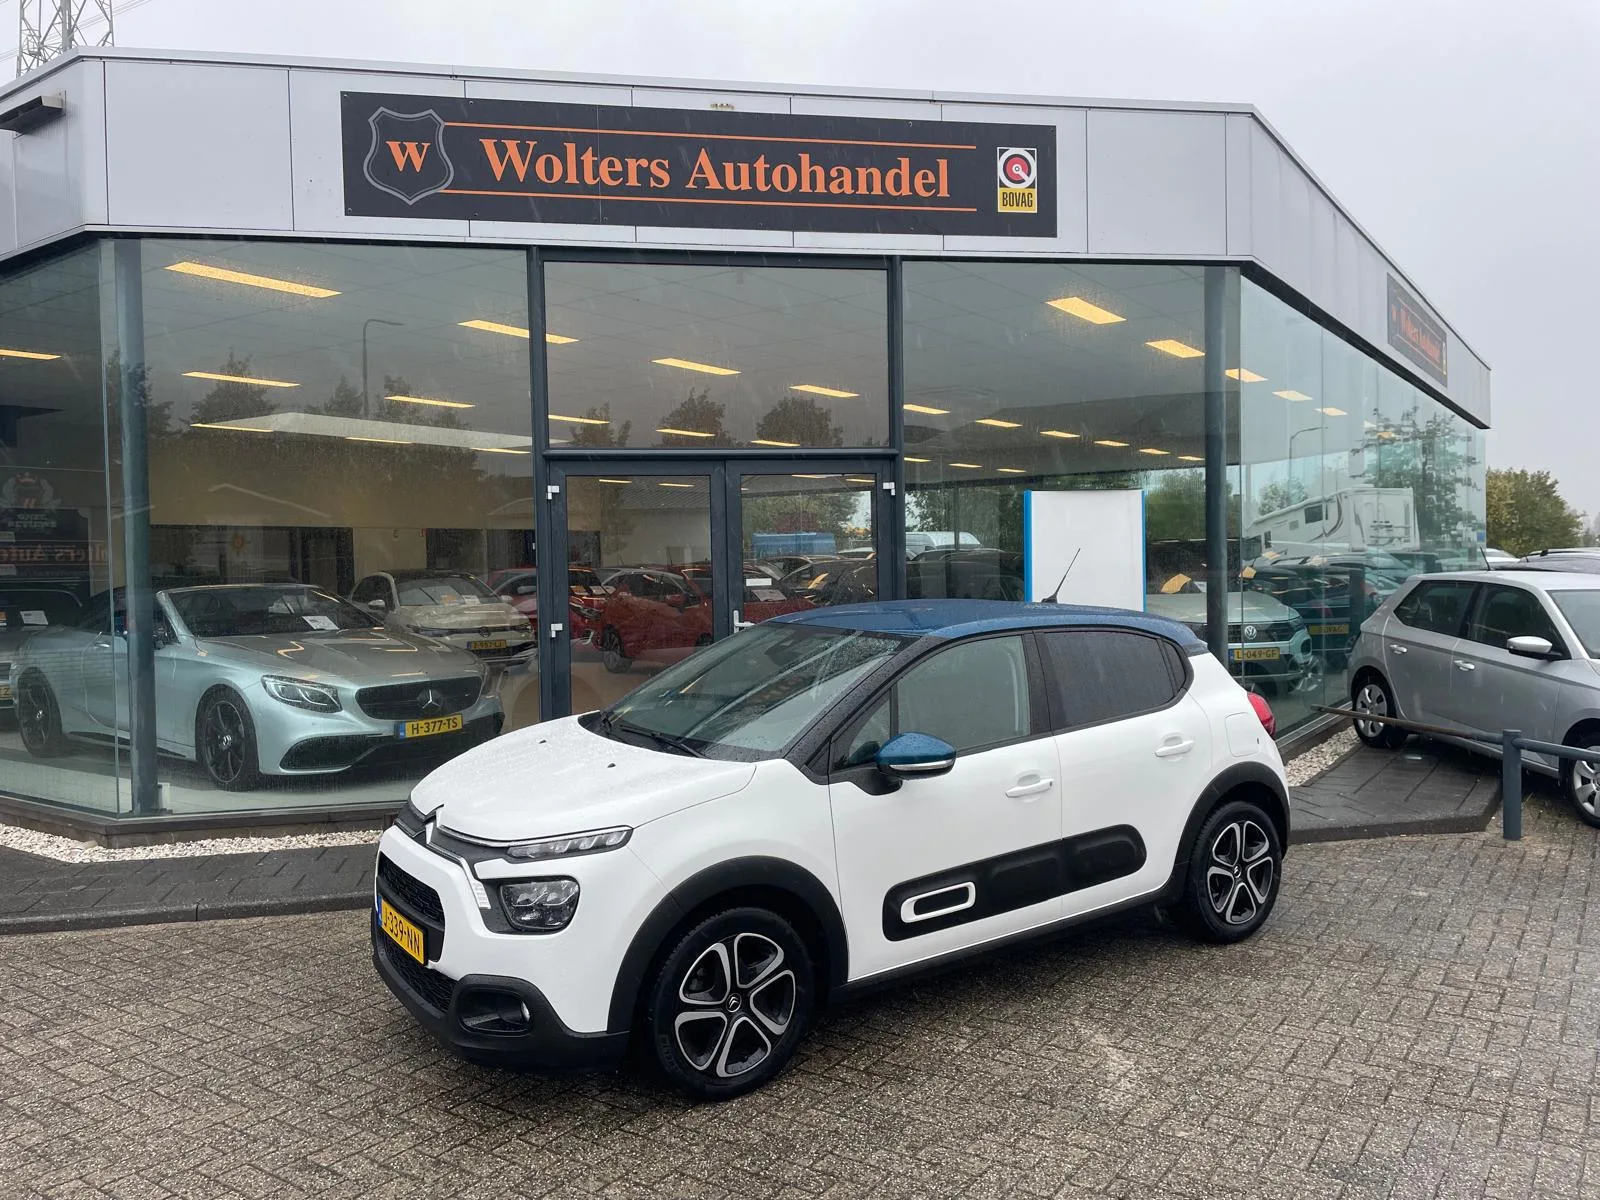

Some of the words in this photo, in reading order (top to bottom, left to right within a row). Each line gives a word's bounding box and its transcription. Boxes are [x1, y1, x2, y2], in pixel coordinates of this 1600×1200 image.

[386, 140, 431, 173] W
[479, 138, 671, 188] Wolters
[684, 148, 950, 199] Autohandel
[1002, 192, 1033, 208] BOVAG
[411, 716, 458, 735] H-377-TS
[384, 908, 420, 956] J-339-NN
